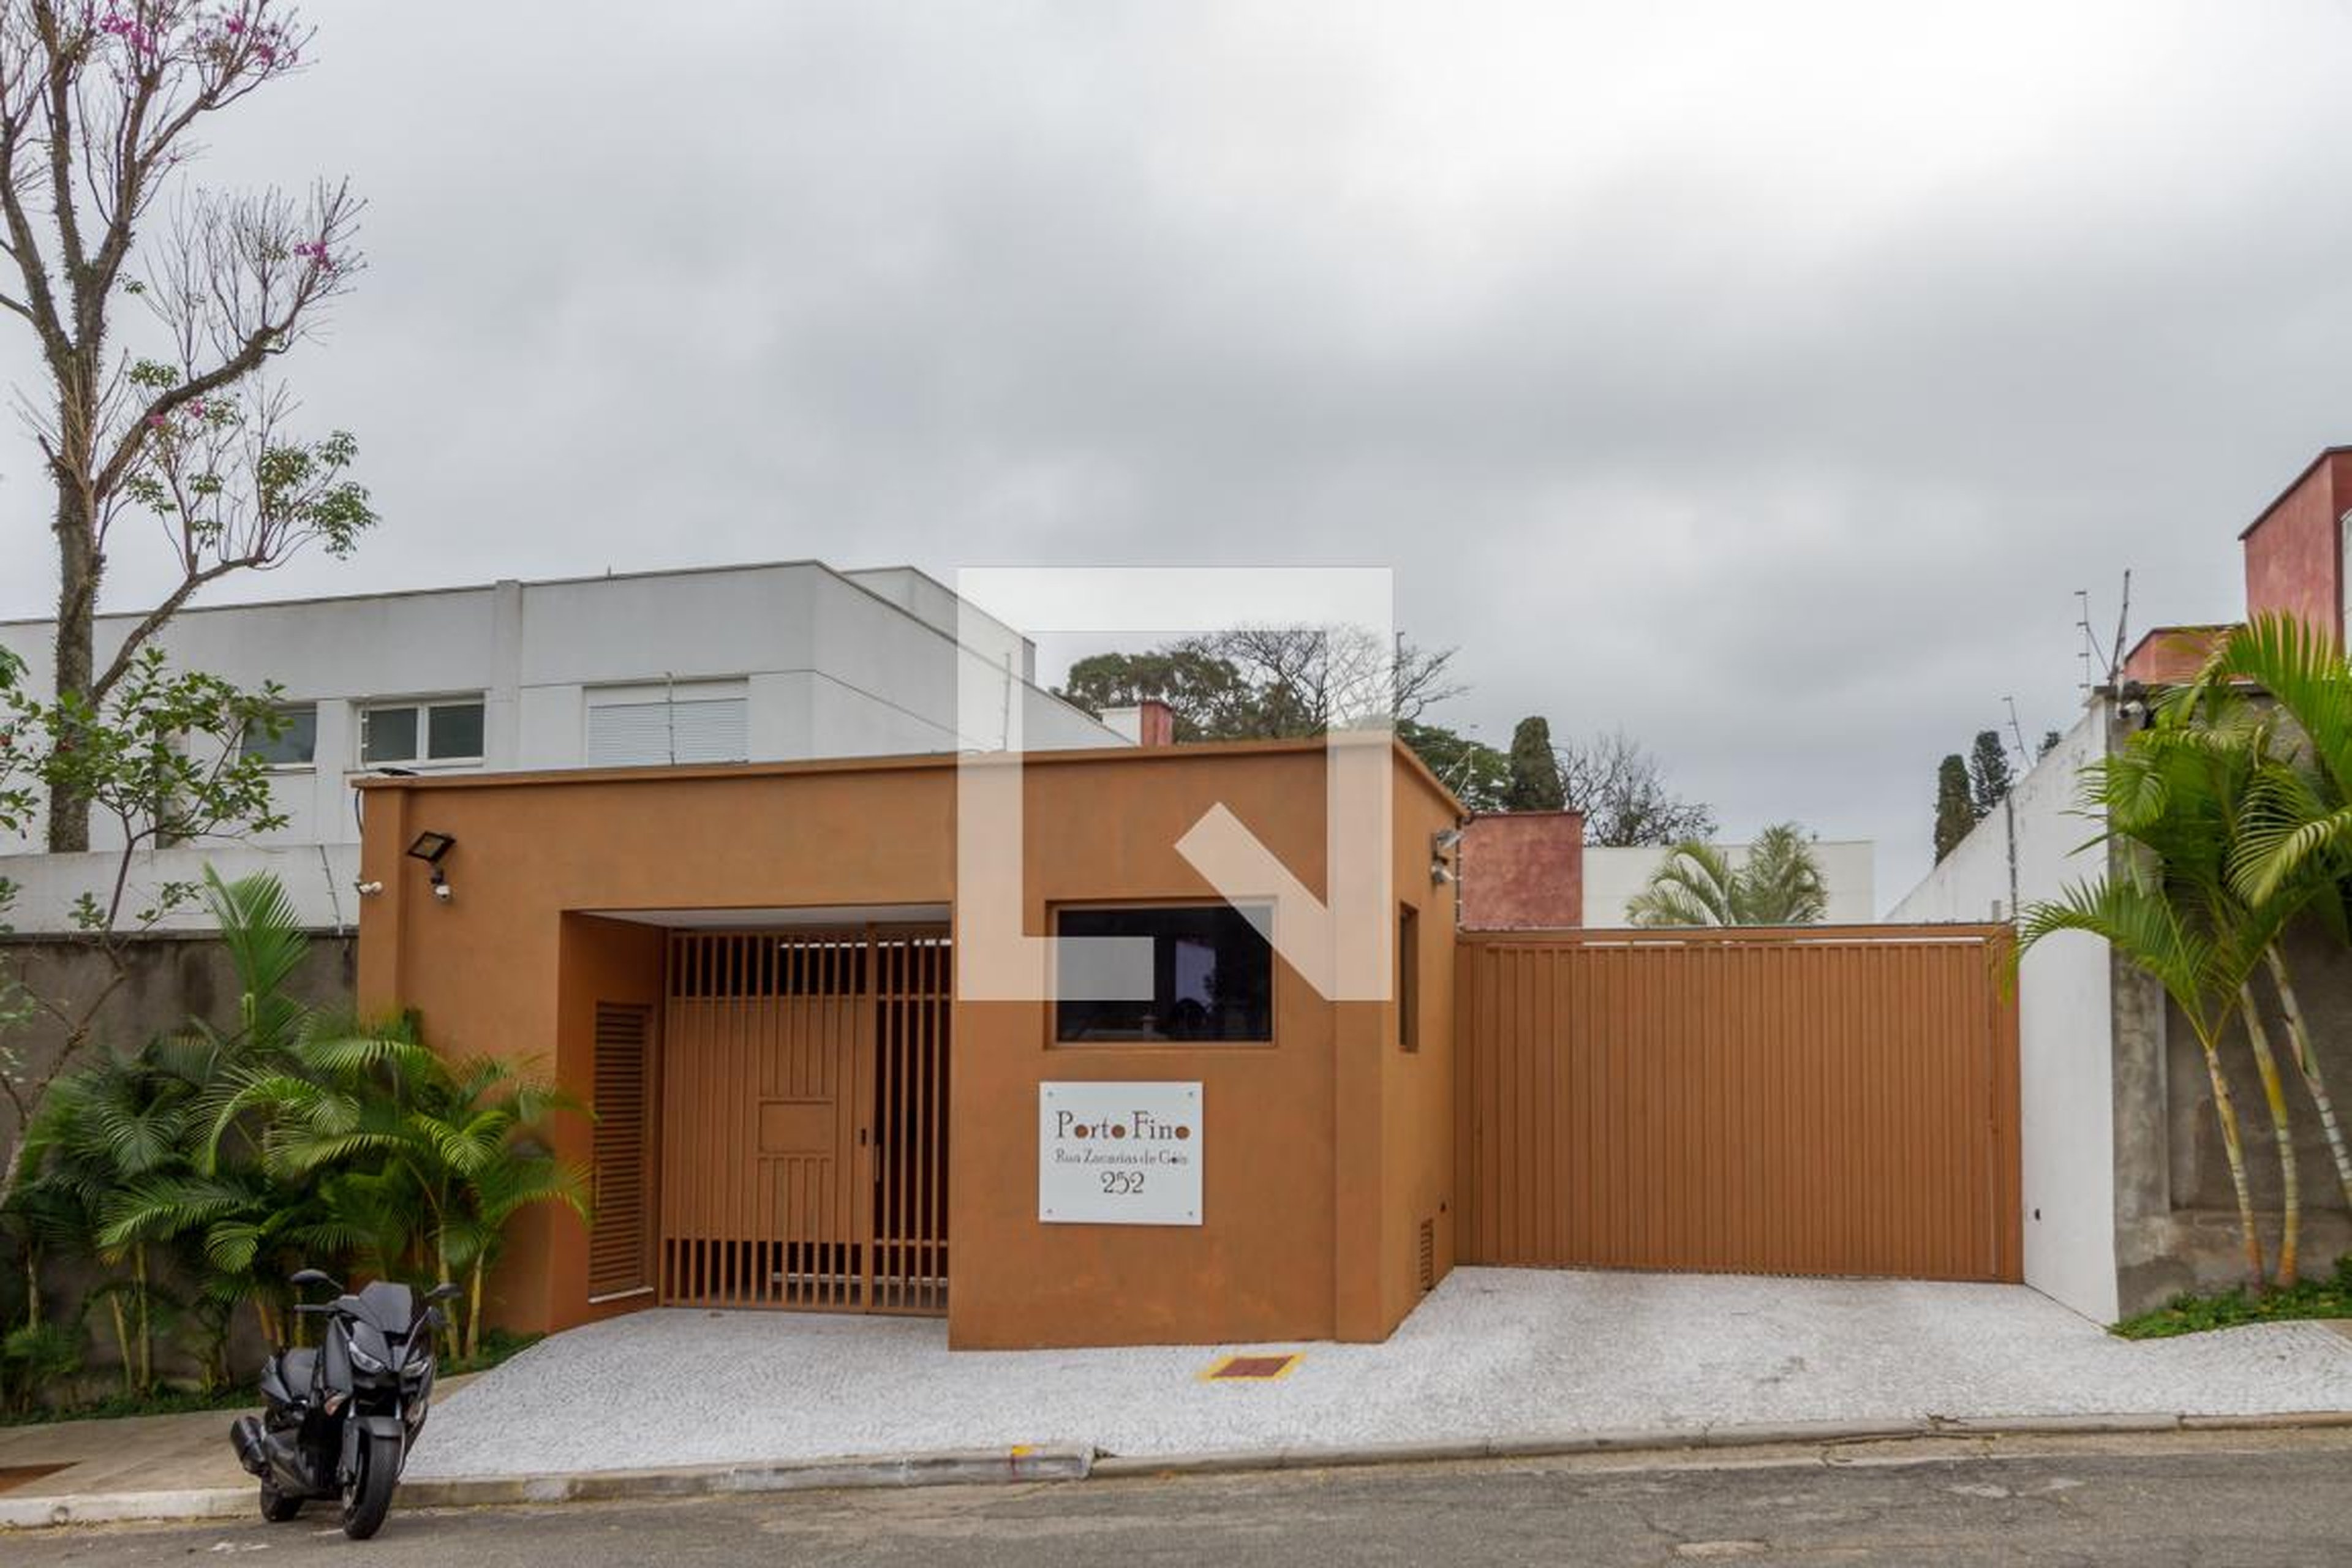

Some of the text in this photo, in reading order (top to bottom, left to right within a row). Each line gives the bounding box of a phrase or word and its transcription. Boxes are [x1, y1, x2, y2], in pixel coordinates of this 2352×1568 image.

[1056, 1110, 1191, 1140] Porto Fino
[1055, 1148, 1081, 1163] Rua
[1139, 1149, 1156, 1164] de
[1101, 1171, 1145, 1194] 252
